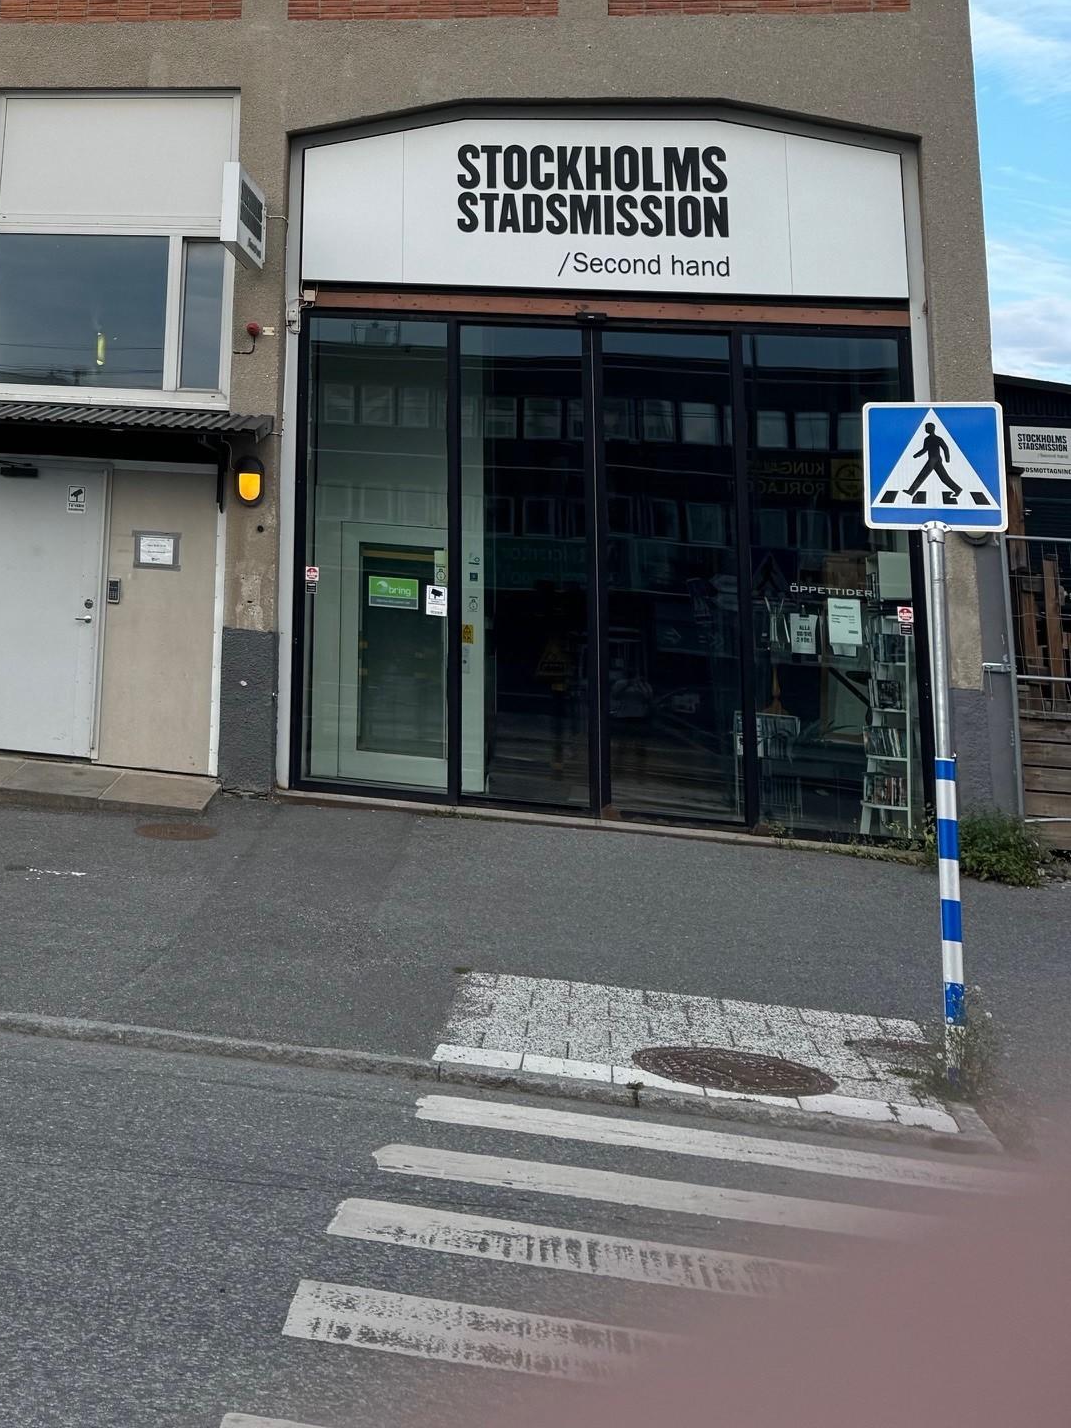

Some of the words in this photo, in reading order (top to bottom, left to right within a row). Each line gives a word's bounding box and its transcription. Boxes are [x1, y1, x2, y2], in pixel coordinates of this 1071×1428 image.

[458, 144, 728, 194] STOCKHOLMS
[457, 192, 730, 238] STADSMISSION
[670, 254, 731, 279] hand
[1017, 433, 1068, 444] STOCKHOLMS
[1017, 442, 1068, 453] STADSMISSION
[388, 586, 412, 597] bring
[789, 582, 874, 598] ÖPPETTIDER
